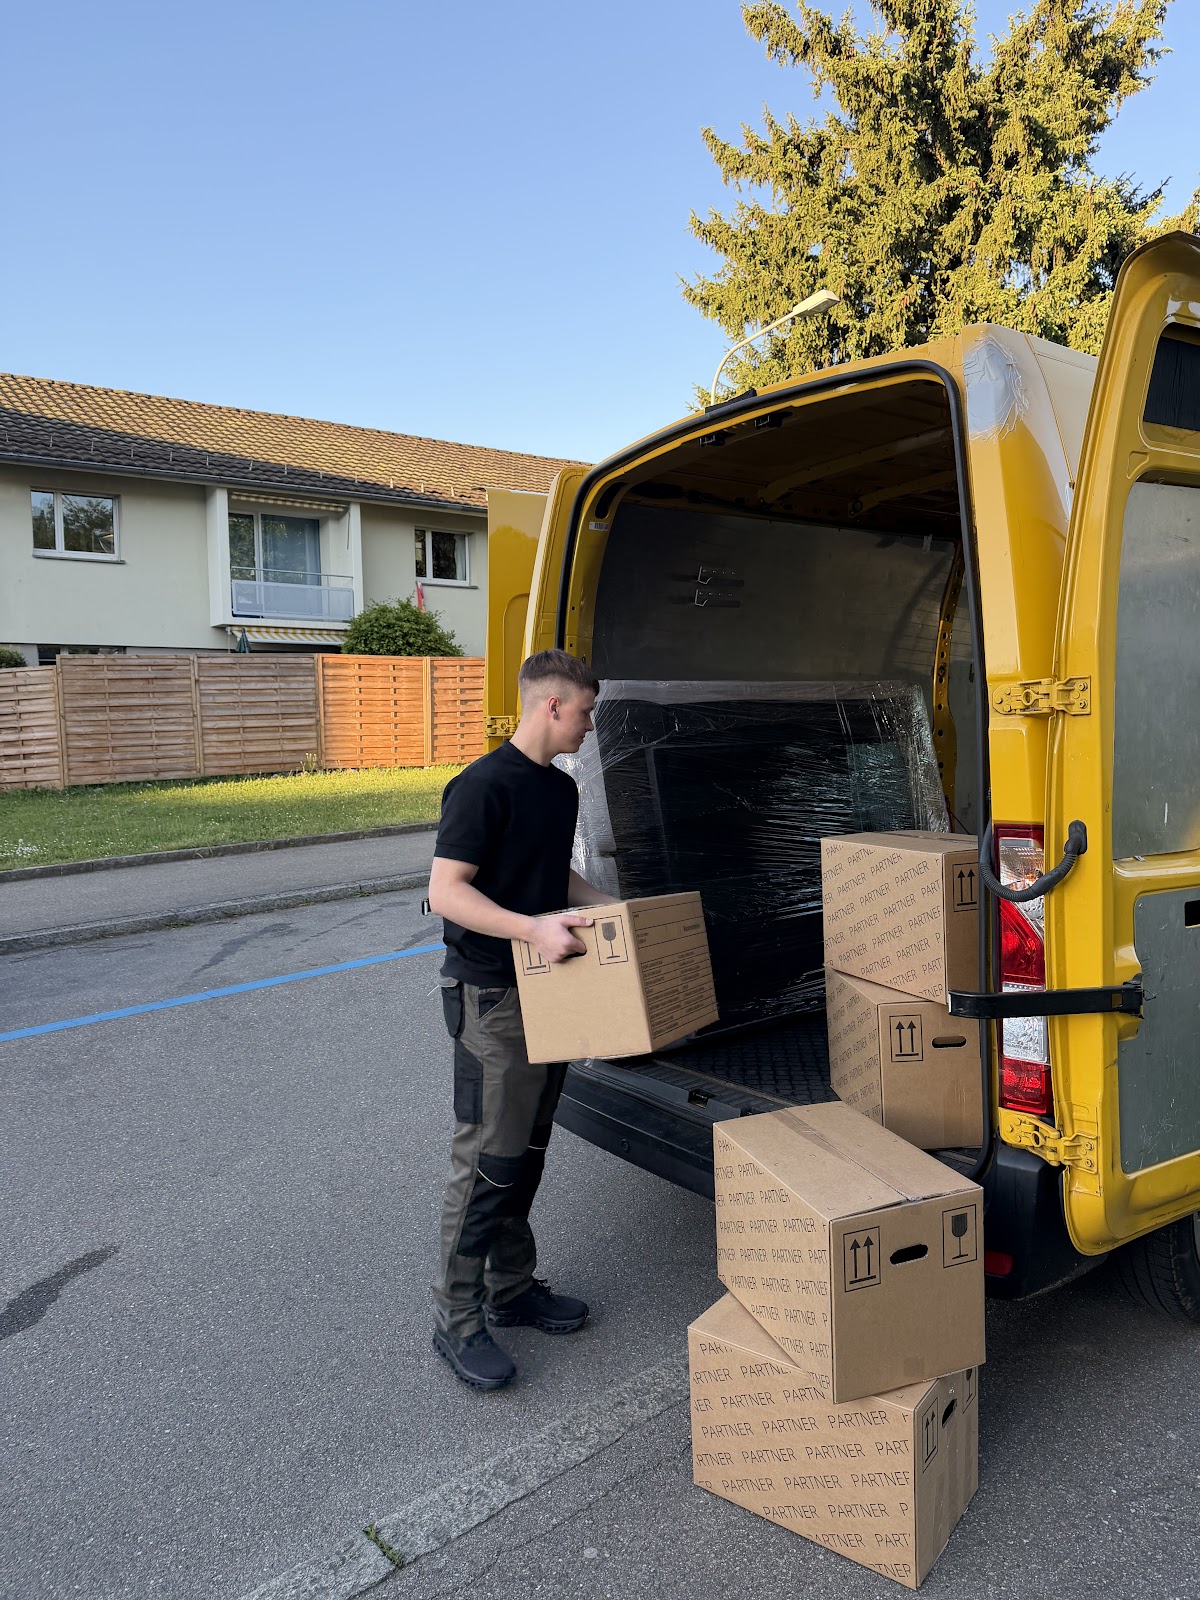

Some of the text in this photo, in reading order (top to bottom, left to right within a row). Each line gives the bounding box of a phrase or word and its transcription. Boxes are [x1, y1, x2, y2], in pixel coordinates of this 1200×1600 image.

[822, 862, 844, 882] RTNER
[827, 860, 930, 925] PARTNER PARTNER PARTNER
[837, 872, 867, 896] PARTNER
[848, 914, 880, 937] PARTNER
[883, 893, 917, 918] PARTNER
[838, 944, 868, 966] PARTNER
[872, 925, 905, 948] PARTNER
[896, 938, 930, 962] PARTNER
[728, 1192, 756, 1206] PARTNER
[720, 1220, 746, 1234] PARTNER
[750, 1219, 779, 1234] PARTNER
[782, 1218, 816, 1232] PARTNER
[740, 1248, 768, 1262] PARTNER
[772, 1249, 804, 1264] PARTNER
[730, 1275, 758, 1290] PARTNER
[761, 1277, 792, 1293] PARTNER
[751, 1304, 781, 1321] PARTNER
[784, 1308, 818, 1326] PARTNER
[720, 1392, 775, 1410] PARTNER
[702, 1422, 754, 1439] PARTNER
[762, 1416, 819, 1434] PARTNER
[828, 1410, 890, 1428] PARTNER
[696, 1452, 734, 1467] RTNER
[742, 1448, 797, 1464] PARTNER
[805, 1443, 866, 1460] PARTNER
[722, 1478, 776, 1493] PARTNER
[784, 1474, 842, 1490] PARTNER
[763, 1502, 909, 1519] PARTNER PARTNER P
